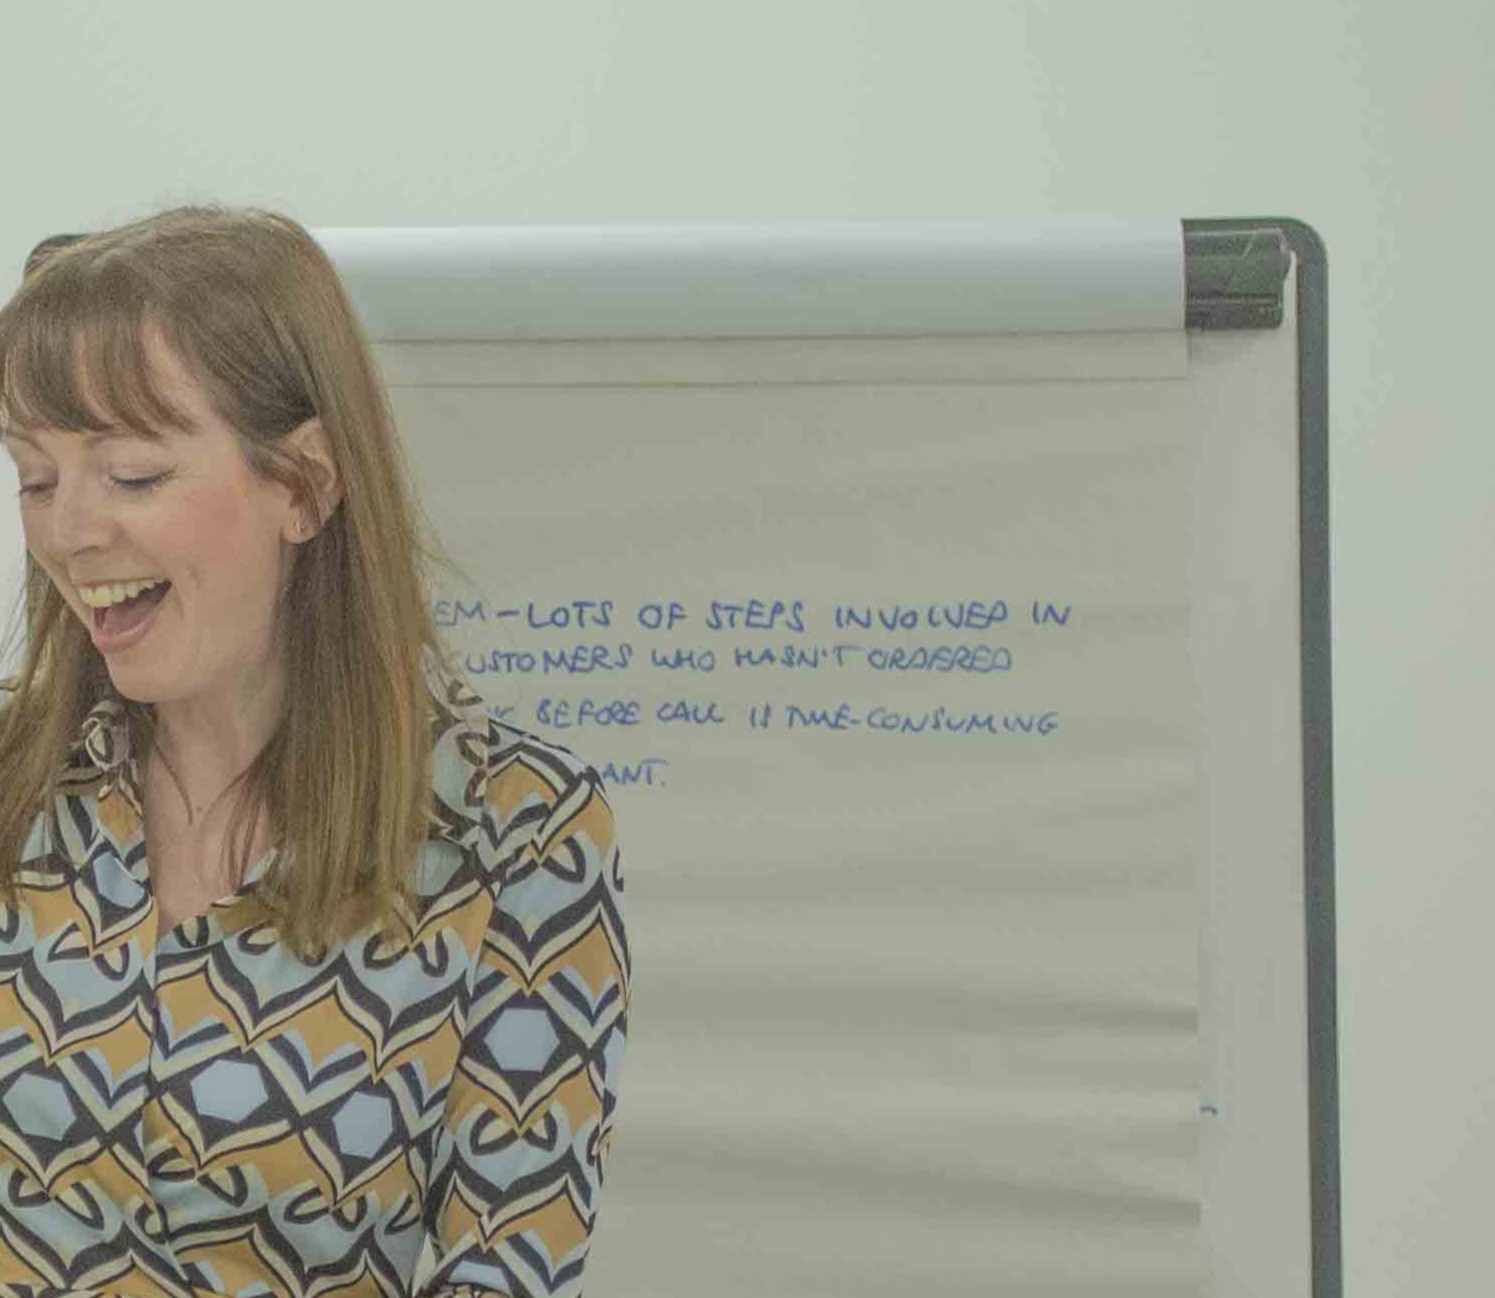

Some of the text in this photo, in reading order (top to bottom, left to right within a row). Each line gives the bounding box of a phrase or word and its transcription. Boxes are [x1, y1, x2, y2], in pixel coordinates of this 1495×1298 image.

[638, 603, 688, 630] OF
[706, 599, 805, 632] STEPS
[834, 600, 1008, 630] INVOLVED
[1032, 601, 1072, 626] IN
[464, 642, 1011, 674] USTOMERS WHO HASN'T ORDERED
[536, 699, 642, 728] BEFORE
[657, 700, 726, 724] CALL
